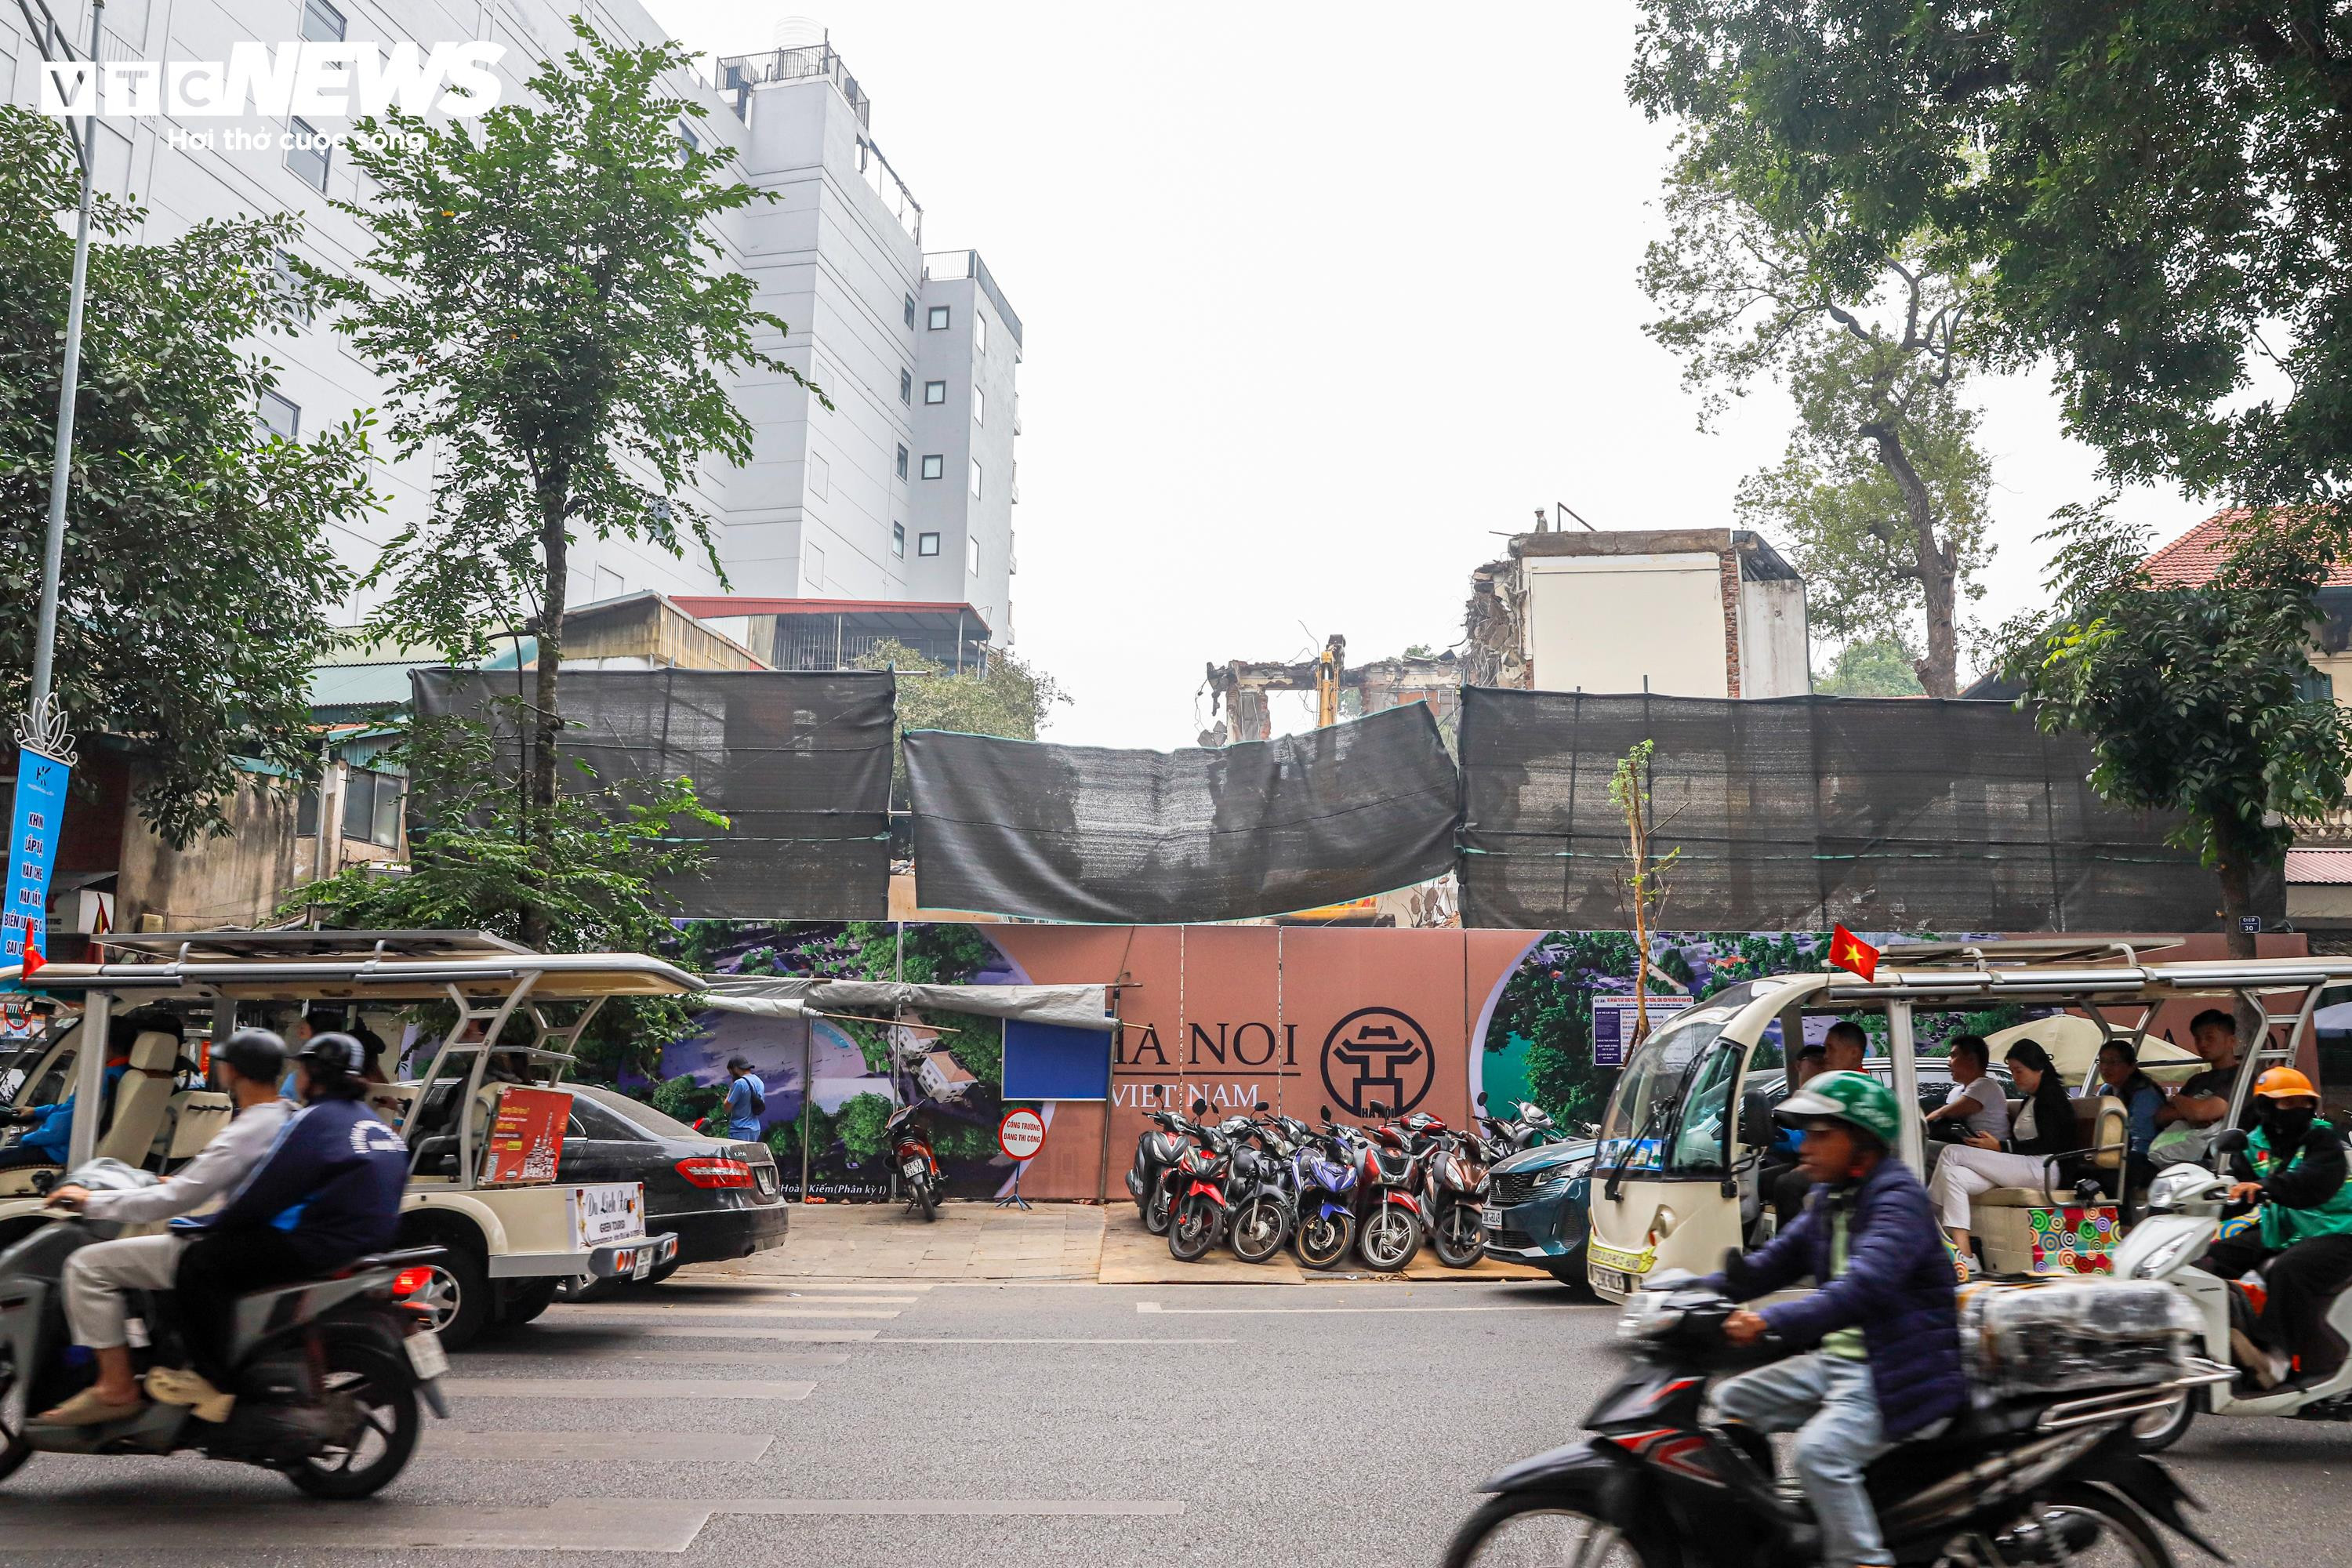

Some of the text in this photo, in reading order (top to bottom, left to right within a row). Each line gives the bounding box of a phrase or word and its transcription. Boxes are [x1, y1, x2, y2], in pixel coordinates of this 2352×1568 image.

[6, 940, 17, 954] SAI
[1187, 1022, 1298, 1065] NOI
[1112, 1083, 1259, 1108] VIET NAM
[1007, 1120, 1020, 1129] CÔNG
[1027, 1134, 1040, 1143] CÔNG
[865, 1185, 877, 1196] kỳ
